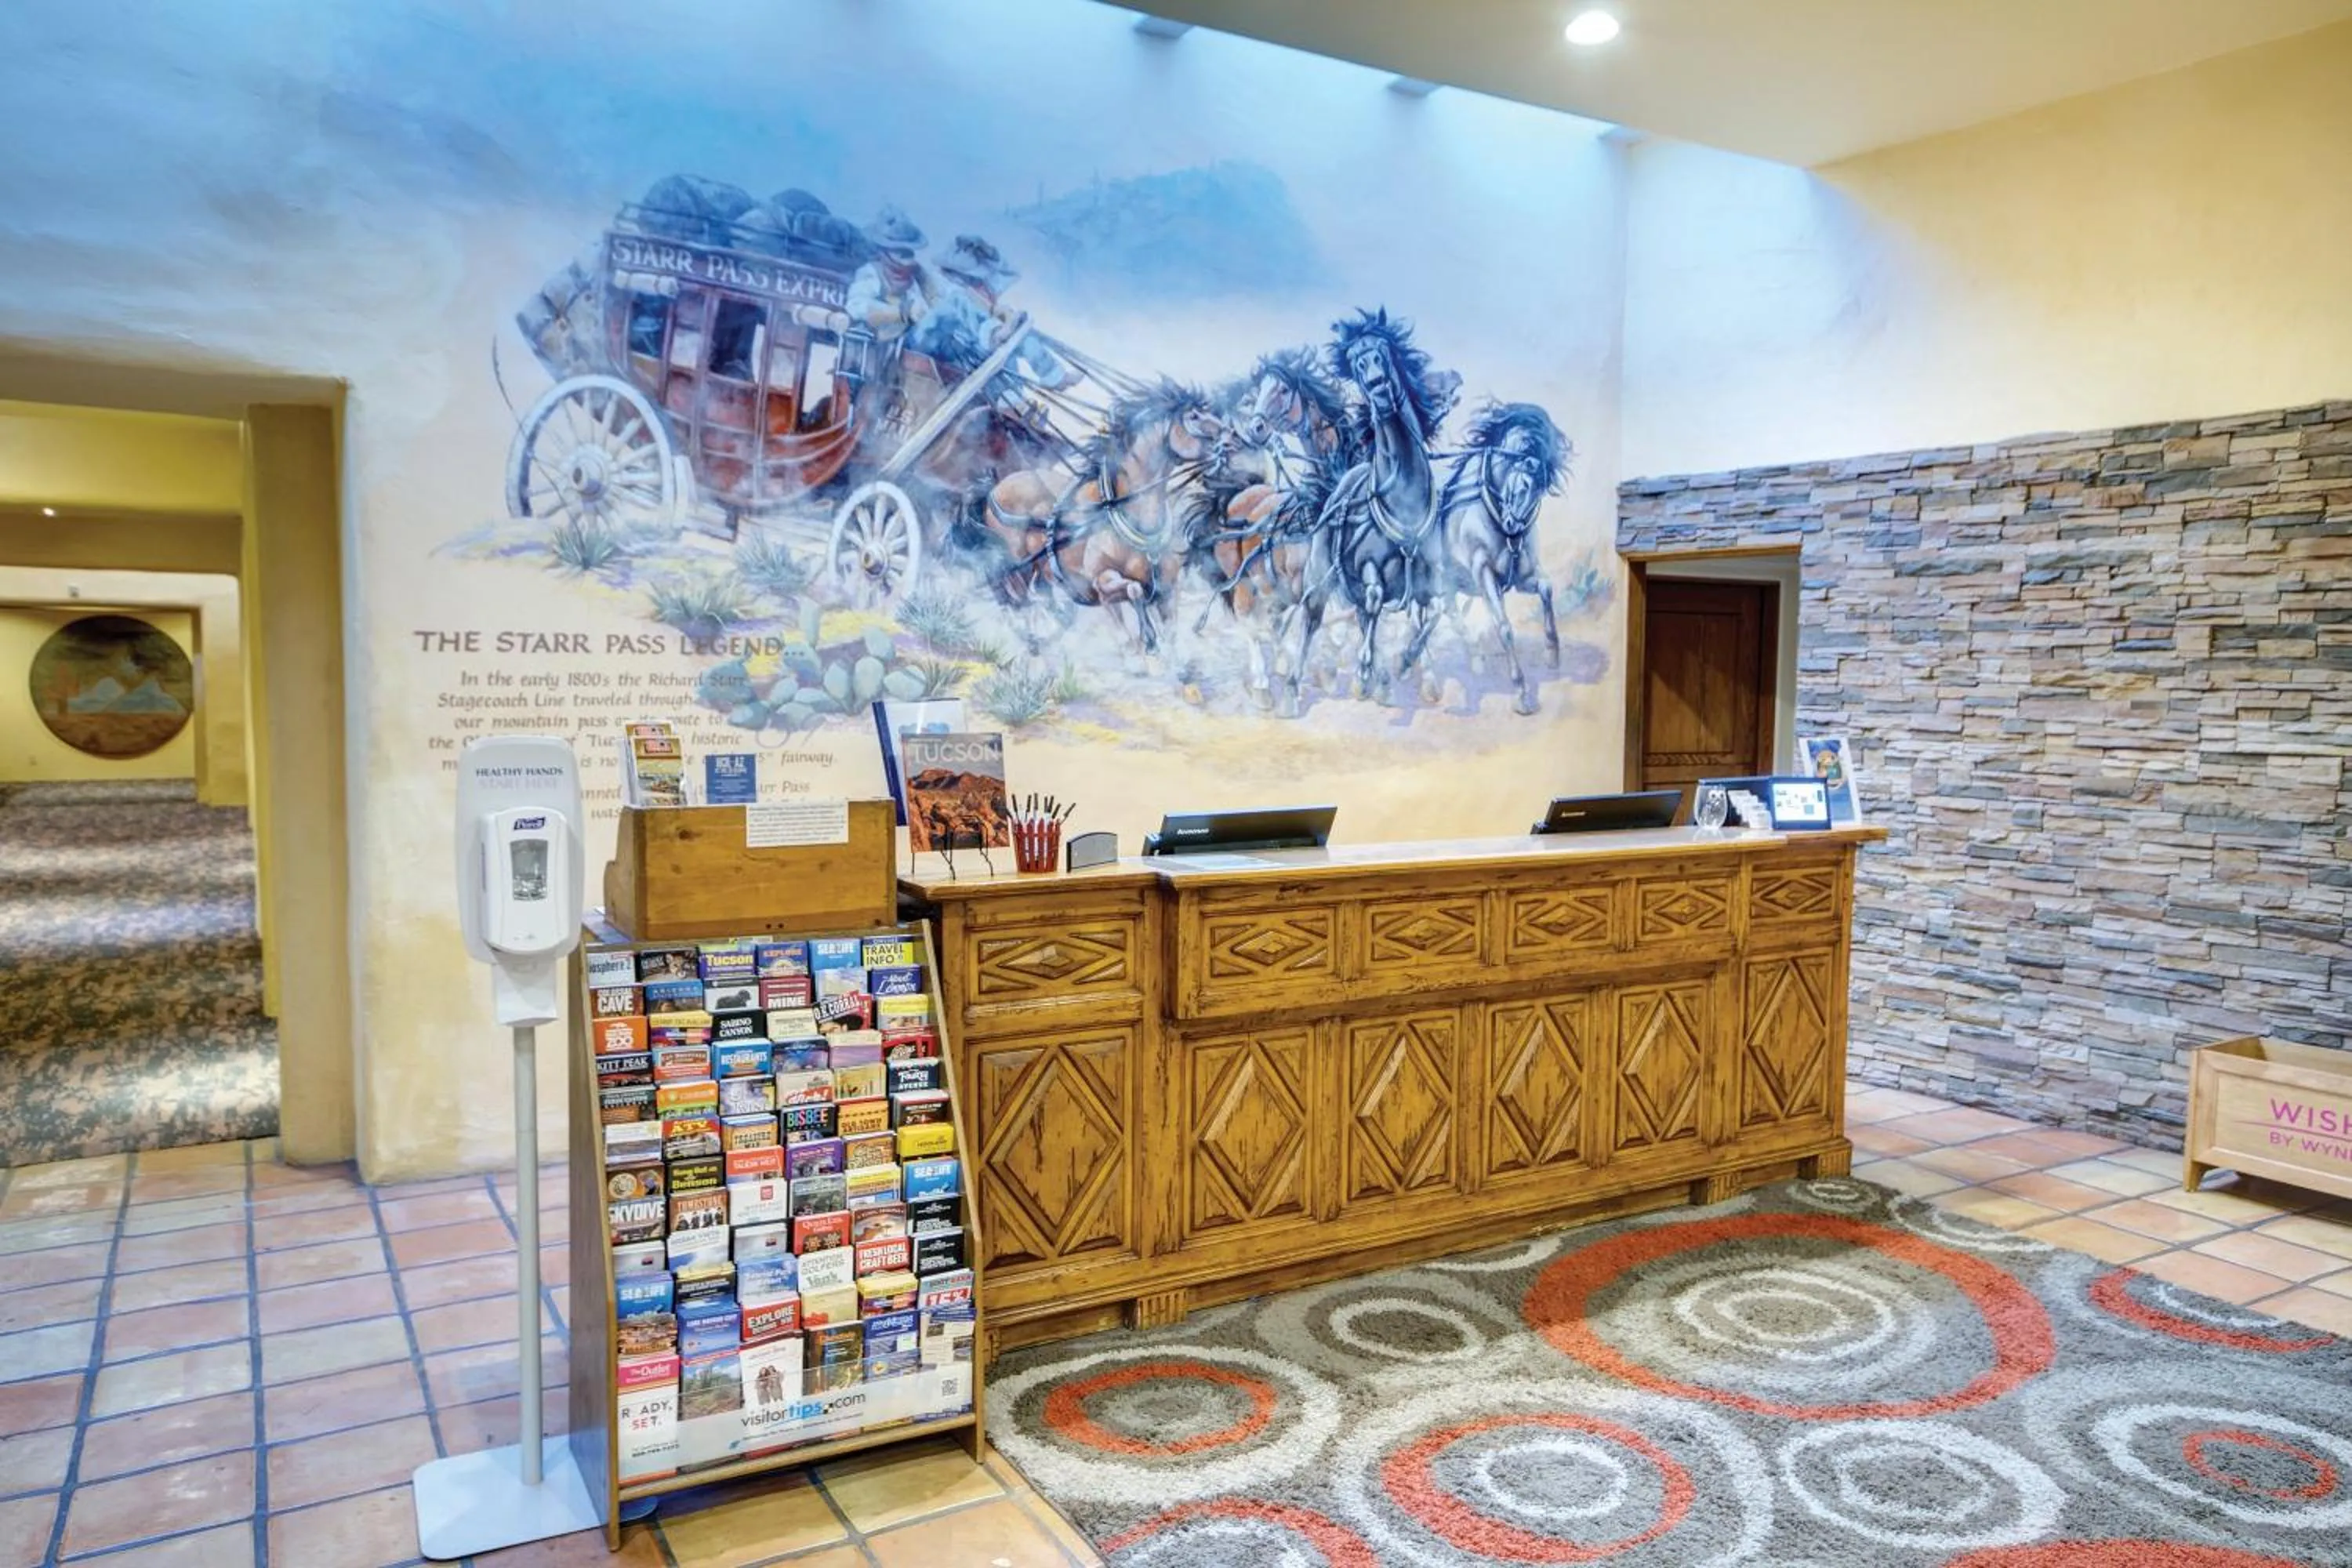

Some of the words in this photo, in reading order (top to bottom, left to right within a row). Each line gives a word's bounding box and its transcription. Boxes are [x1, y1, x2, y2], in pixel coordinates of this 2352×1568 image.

[612, 238, 694, 272] STARR
[706, 255, 768, 289] PASS
[413, 630, 482, 652] THE
[495, 631, 591, 654] STARR
[606, 633, 666, 655] PASS
[461, 670, 478, 686] In
[488, 670, 513, 686] the
[521, 672, 559, 691] early
[568, 672, 610, 687] 1800s
[619, 671, 642, 687] the
[648, 671, 702, 686] Richard
[437, 691, 528, 712] Stagecoach
[535, 692, 564, 706] Line
[573, 690, 632, 706] traveled
[639, 691, 692, 711] through
[454, 717, 484, 729] our
[492, 714, 568, 728] mountain
[578, 715, 608, 731] pass
[709, 713, 720, 725] to
[429, 736, 454, 750] the
[691, 731, 742, 746] historic
[782, 750, 838, 768] fairway.
[910, 741, 1001, 764] TUCSON
[476, 767, 521, 778] HEALTHY
[525, 766, 564, 777] HANDS
[782, 780, 810, 793] Pass
[865, 943, 906, 956] TRAVEL
[590, 959, 624, 975] iosphere
[706, 954, 753, 966] Tucson
[866, 954, 895, 965] INFO
[598, 996, 633, 1012] CAVE
[768, 996, 806, 1009] MINE
[719, 1026, 753, 1037] CANYON
[720, 1017, 753, 1029] SABINO
[607, 1037, 633, 1048] ZOO
[623, 1057, 649, 1068] PEAK
[787, 1107, 829, 1128] BISBEE
[2270, 1131, 2295, 1148] BY
[2301, 1136, 2352, 1163] WYN
[608, 1200, 665, 1224] SKYDIVE
[859, 1255, 887, 1269] CRAFT
[887, 1252, 909, 1265] BEER
[748, 1305, 796, 1327] EXPLORE
[622, 1399, 673, 1418] RADY.
[741, 1392, 866, 1428] visitortips.com
